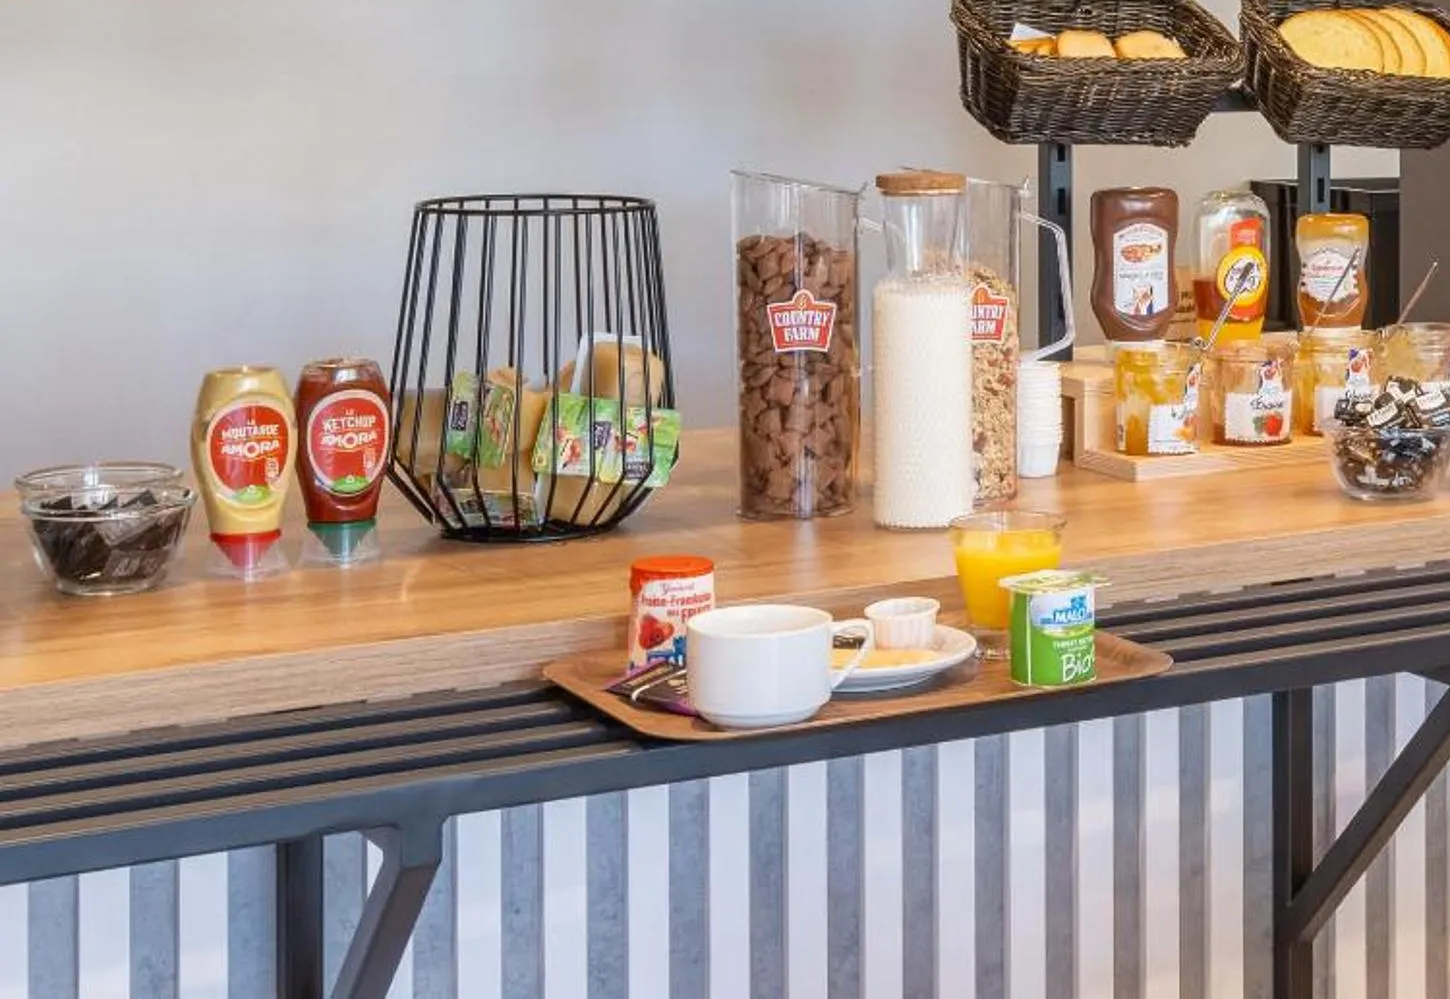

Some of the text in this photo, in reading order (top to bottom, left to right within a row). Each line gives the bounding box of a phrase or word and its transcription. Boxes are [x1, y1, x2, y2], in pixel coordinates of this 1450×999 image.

[774, 309, 830, 327] COUNTRY
[784, 326, 821, 342] FARM
[323, 414, 376, 434] KETCHUP
[321, 430, 377, 449] AMORA
[221, 440, 279, 458] AMORA
